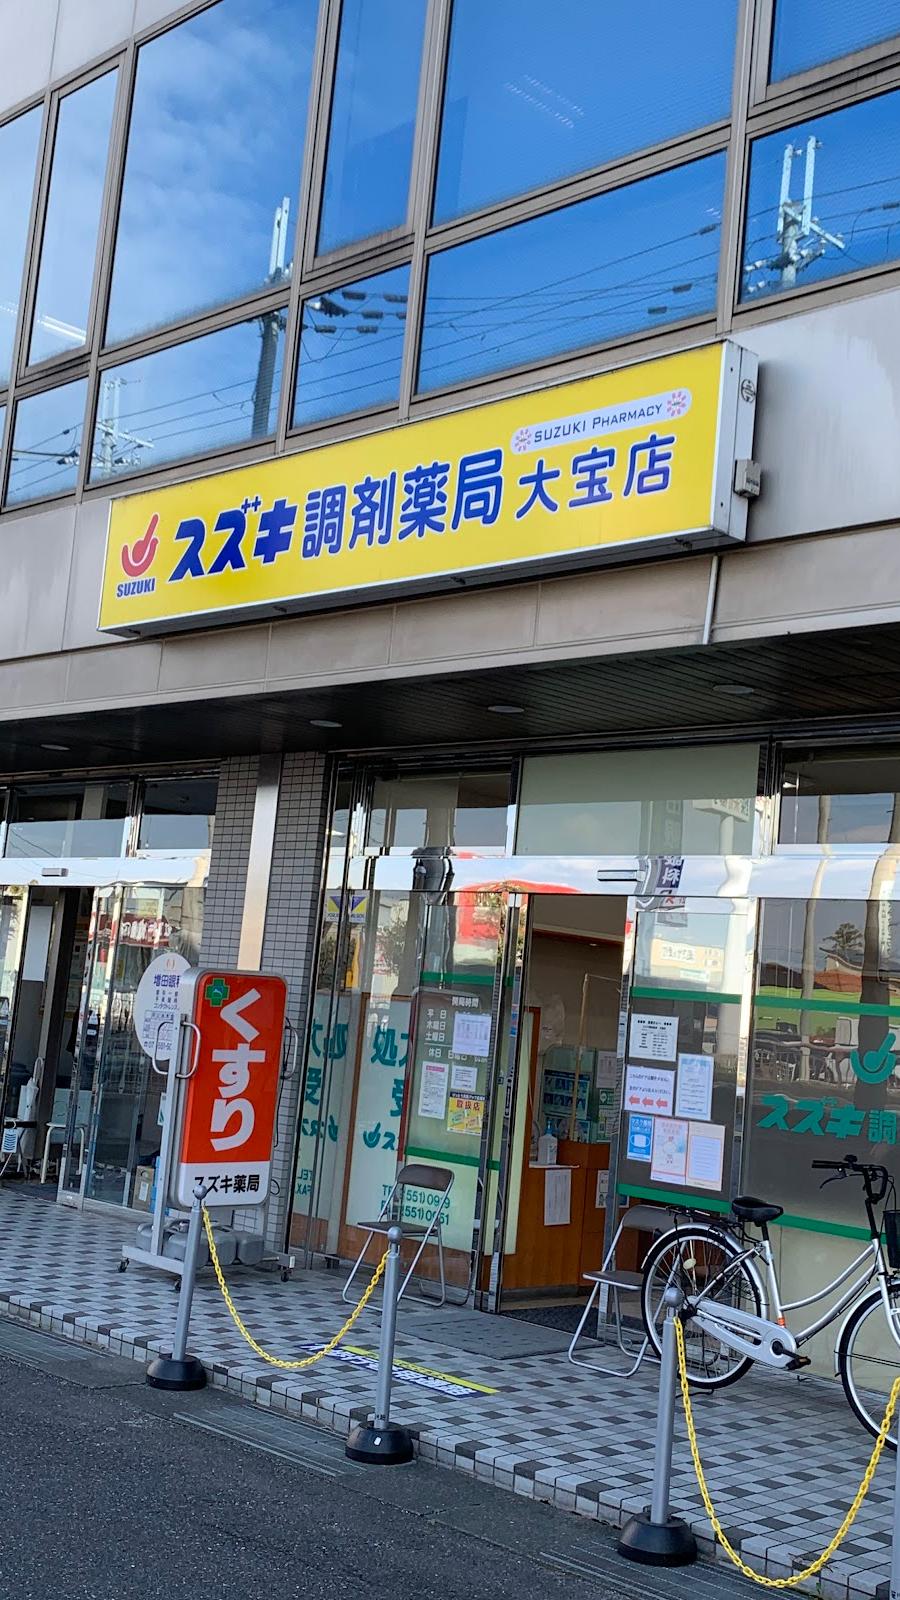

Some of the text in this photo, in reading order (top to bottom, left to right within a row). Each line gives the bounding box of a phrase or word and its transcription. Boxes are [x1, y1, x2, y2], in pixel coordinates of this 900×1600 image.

[534, 418, 587, 443] SUZUKI
[168, 434, 676, 582] スズキ調剤薬局 大宝店
[116, 577, 155, 598] SUZUKI
[210, 987, 266, 1152] くすり
[756, 1094, 897, 1145] スズキ調
